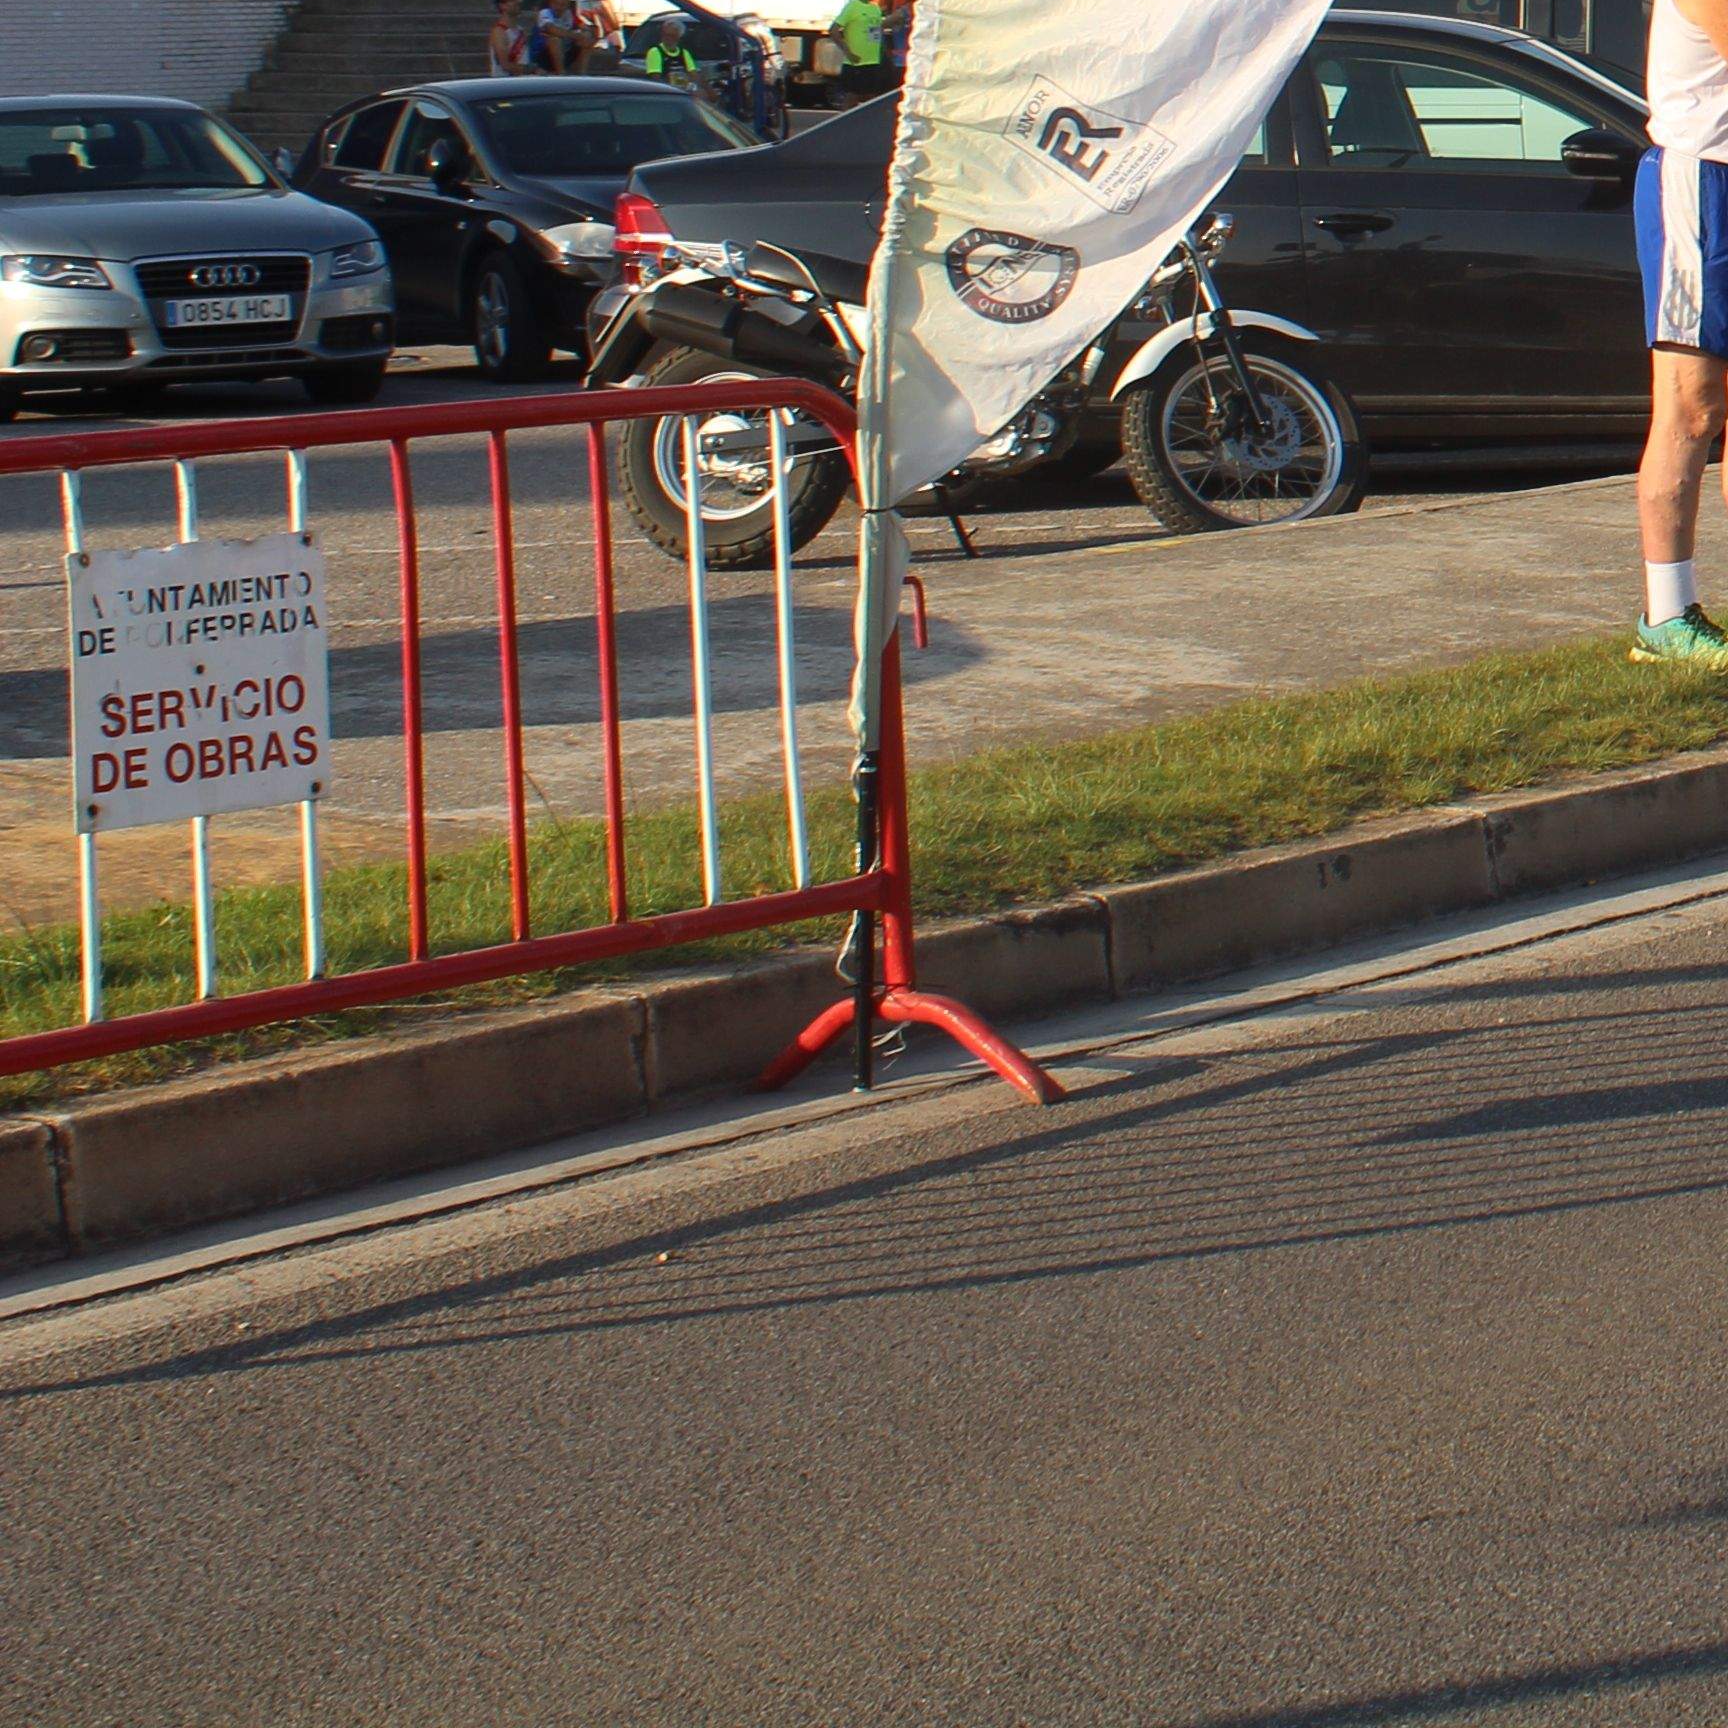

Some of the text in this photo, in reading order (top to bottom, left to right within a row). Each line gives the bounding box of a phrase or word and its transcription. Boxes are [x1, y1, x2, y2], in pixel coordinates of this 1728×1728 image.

[183, 298, 286, 323] 0854 HCJ
[978, 297, 1051, 319] QUALITY
[92, 572, 312, 619] UNTAMIENTO
[78, 627, 116, 657] DE
[101, 674, 306, 739] SERVICIO
[91, 725, 318, 794] DE OBRAS
